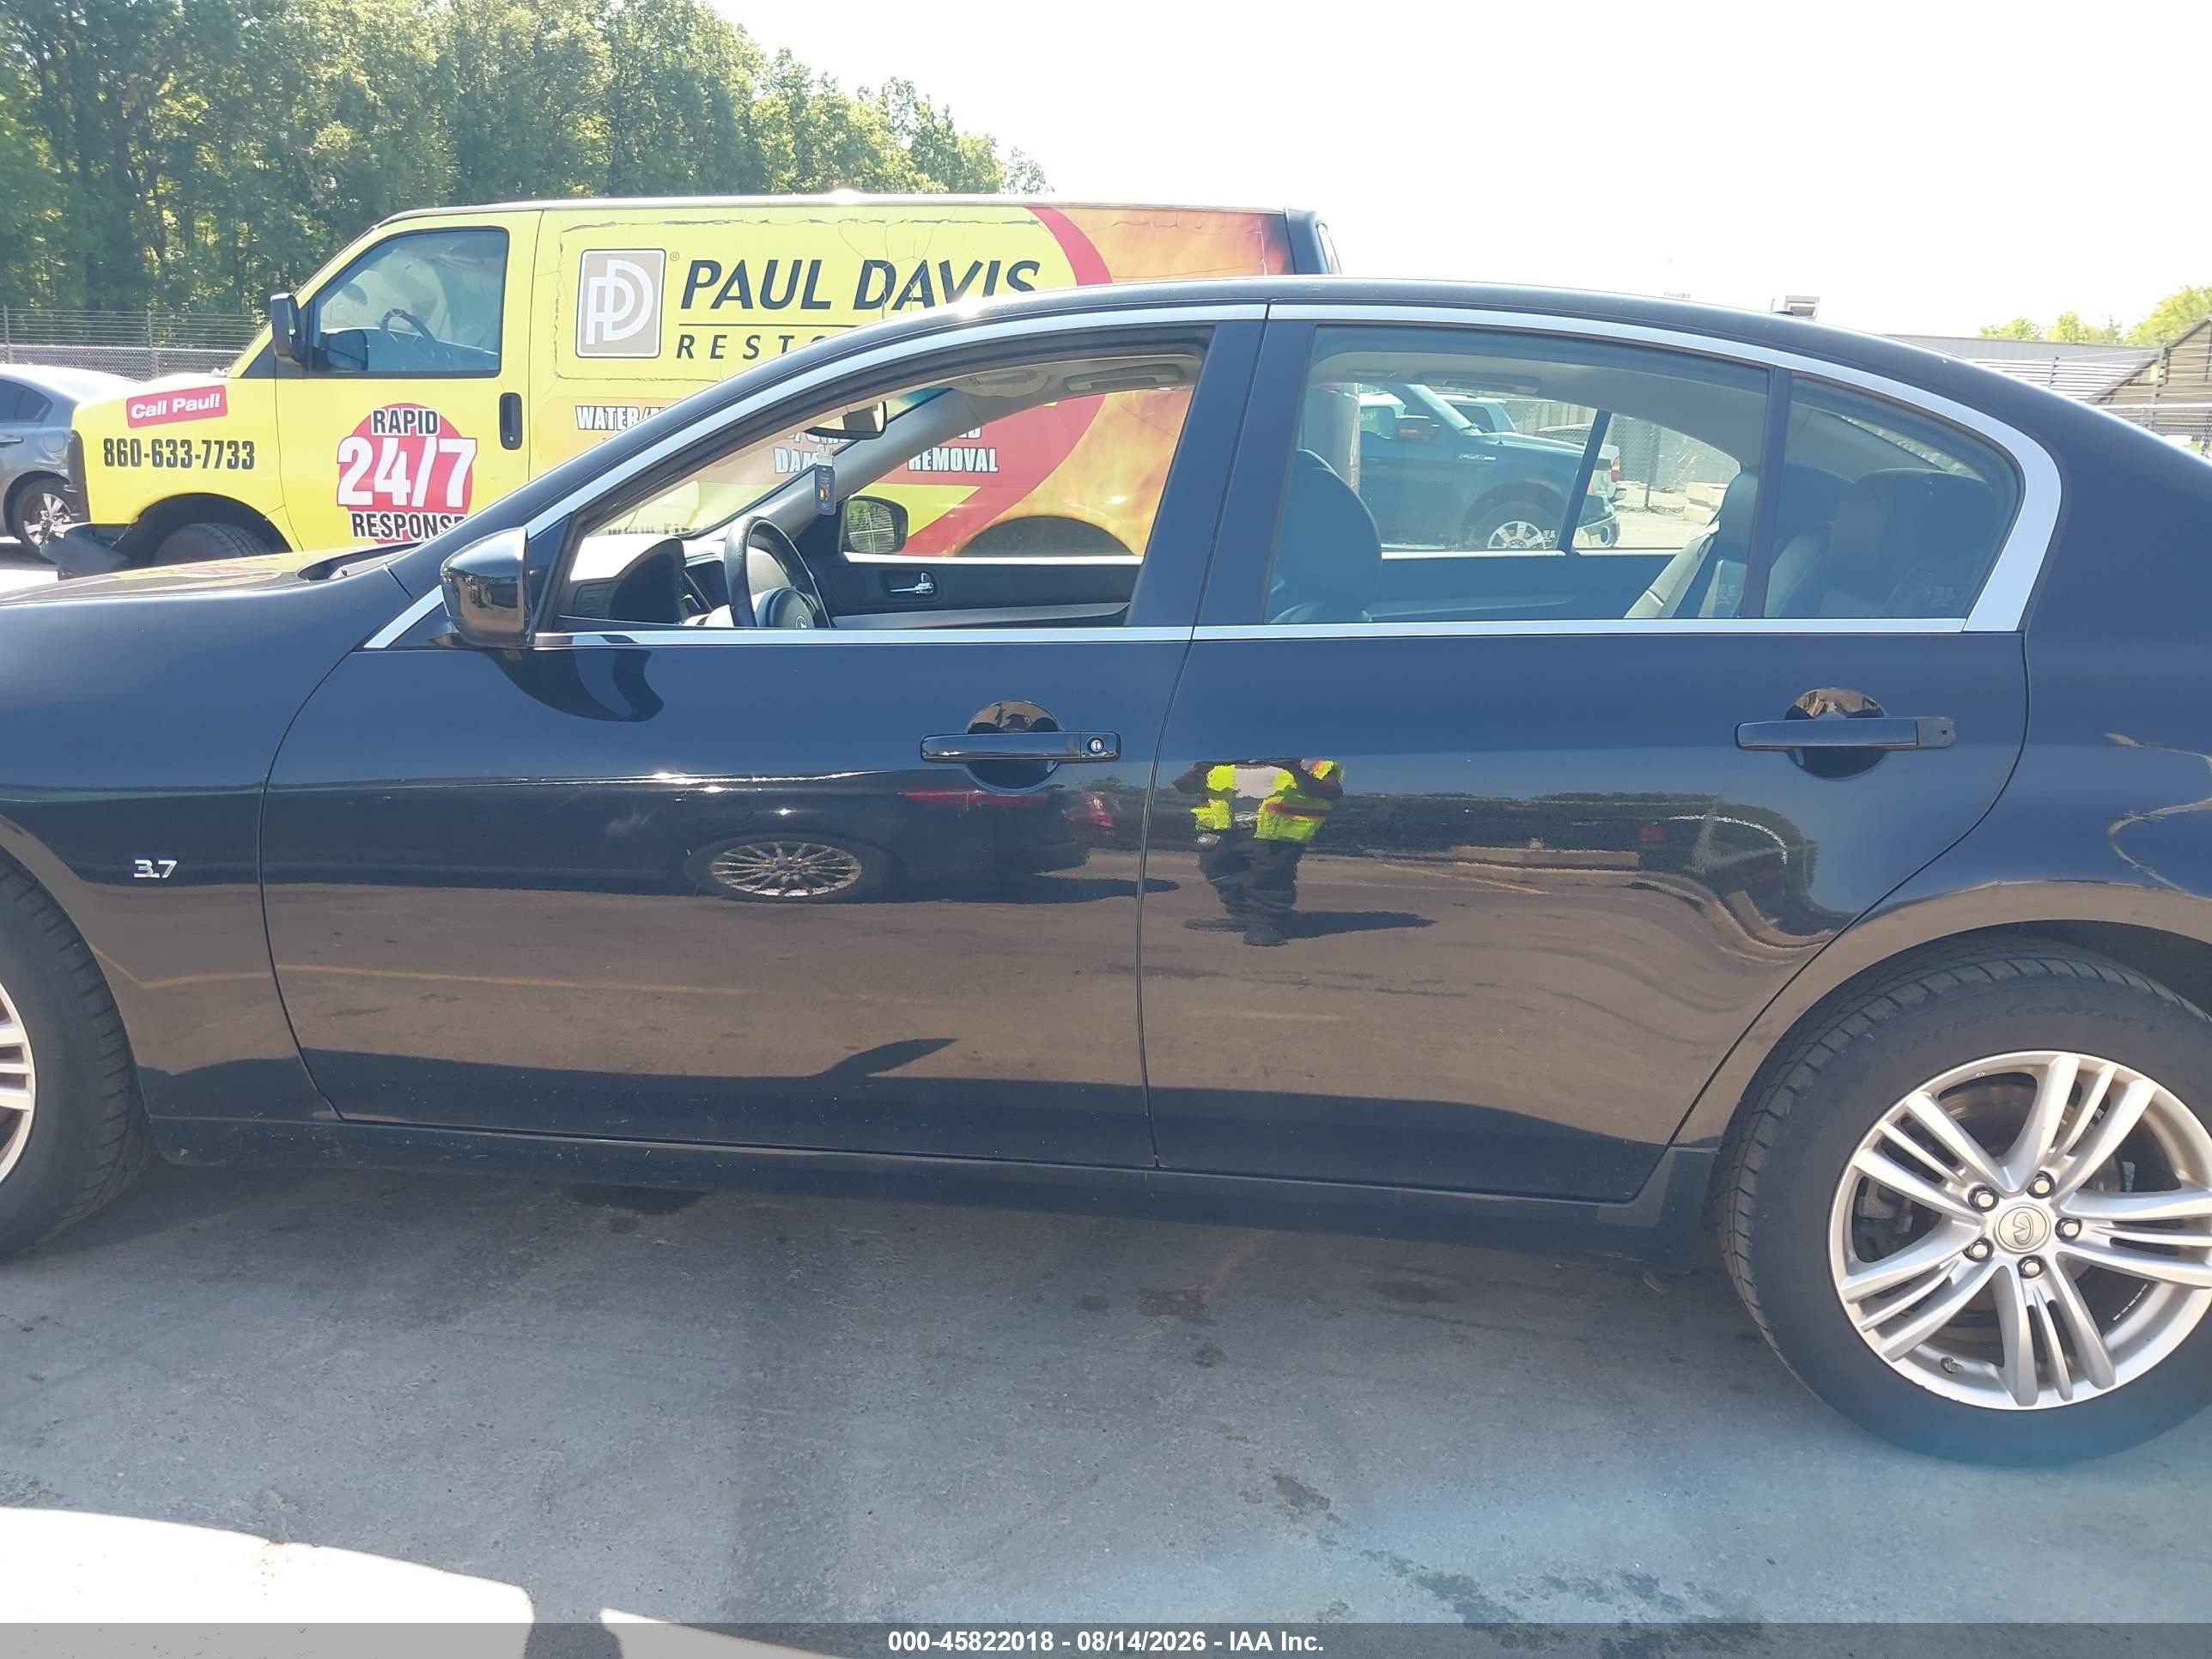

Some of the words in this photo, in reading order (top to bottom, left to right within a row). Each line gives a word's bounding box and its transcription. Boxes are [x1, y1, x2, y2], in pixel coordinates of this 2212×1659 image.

[680, 258, 832, 311] PAUL
[852, 258, 1041, 311] DAVIS
[675, 333, 823, 359] REST
[131, 399, 168, 419] Call
[172, 392, 222, 413] Paul!
[372, 409, 439, 434] RAPID
[102, 437, 256, 471] 860-633-7733
[907, 446, 1000, 473] REMOVAL
[337, 435, 477, 508] 24/7
[351, 512, 466, 539] RESPONS
[133, 859, 178, 878] 3.7
